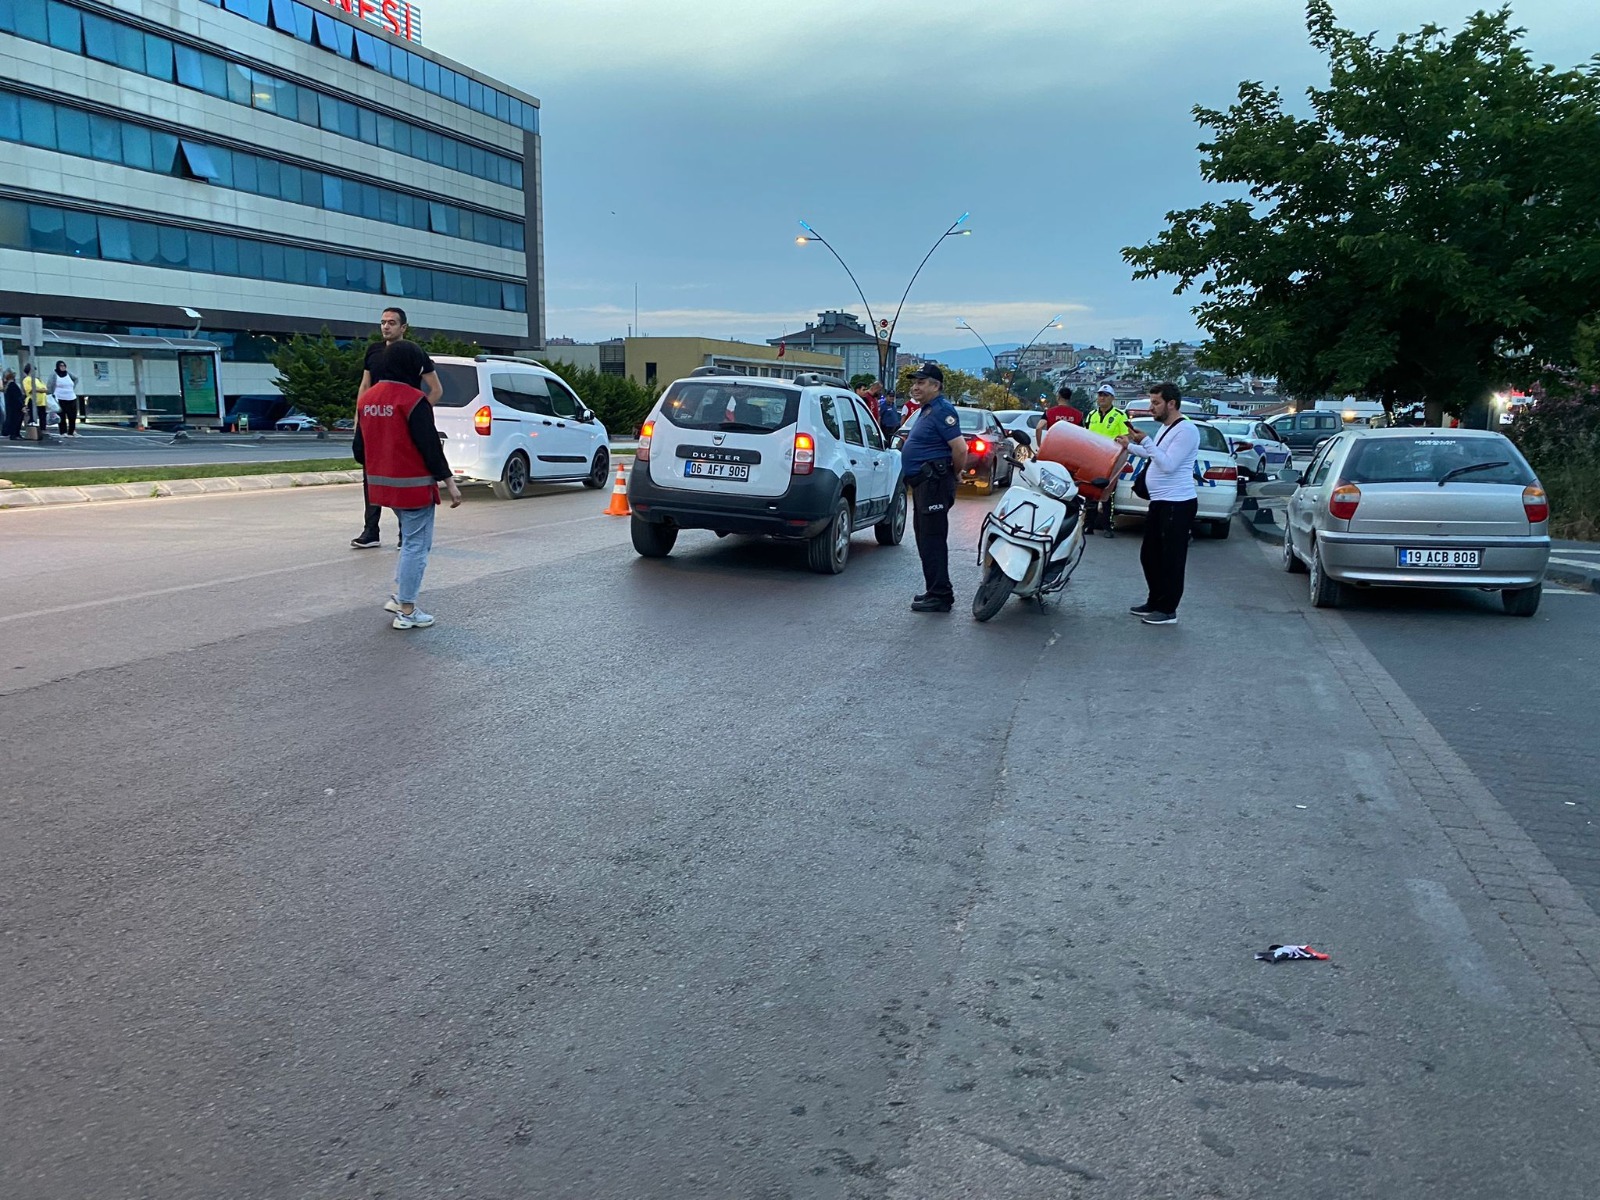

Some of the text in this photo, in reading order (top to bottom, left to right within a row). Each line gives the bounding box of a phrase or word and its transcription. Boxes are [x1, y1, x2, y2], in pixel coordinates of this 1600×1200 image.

[692, 451, 741, 462] DUSTER
[691, 463, 747, 478] 06 AFY 905
[1408, 551, 1477, 563] 19 ACB 808
